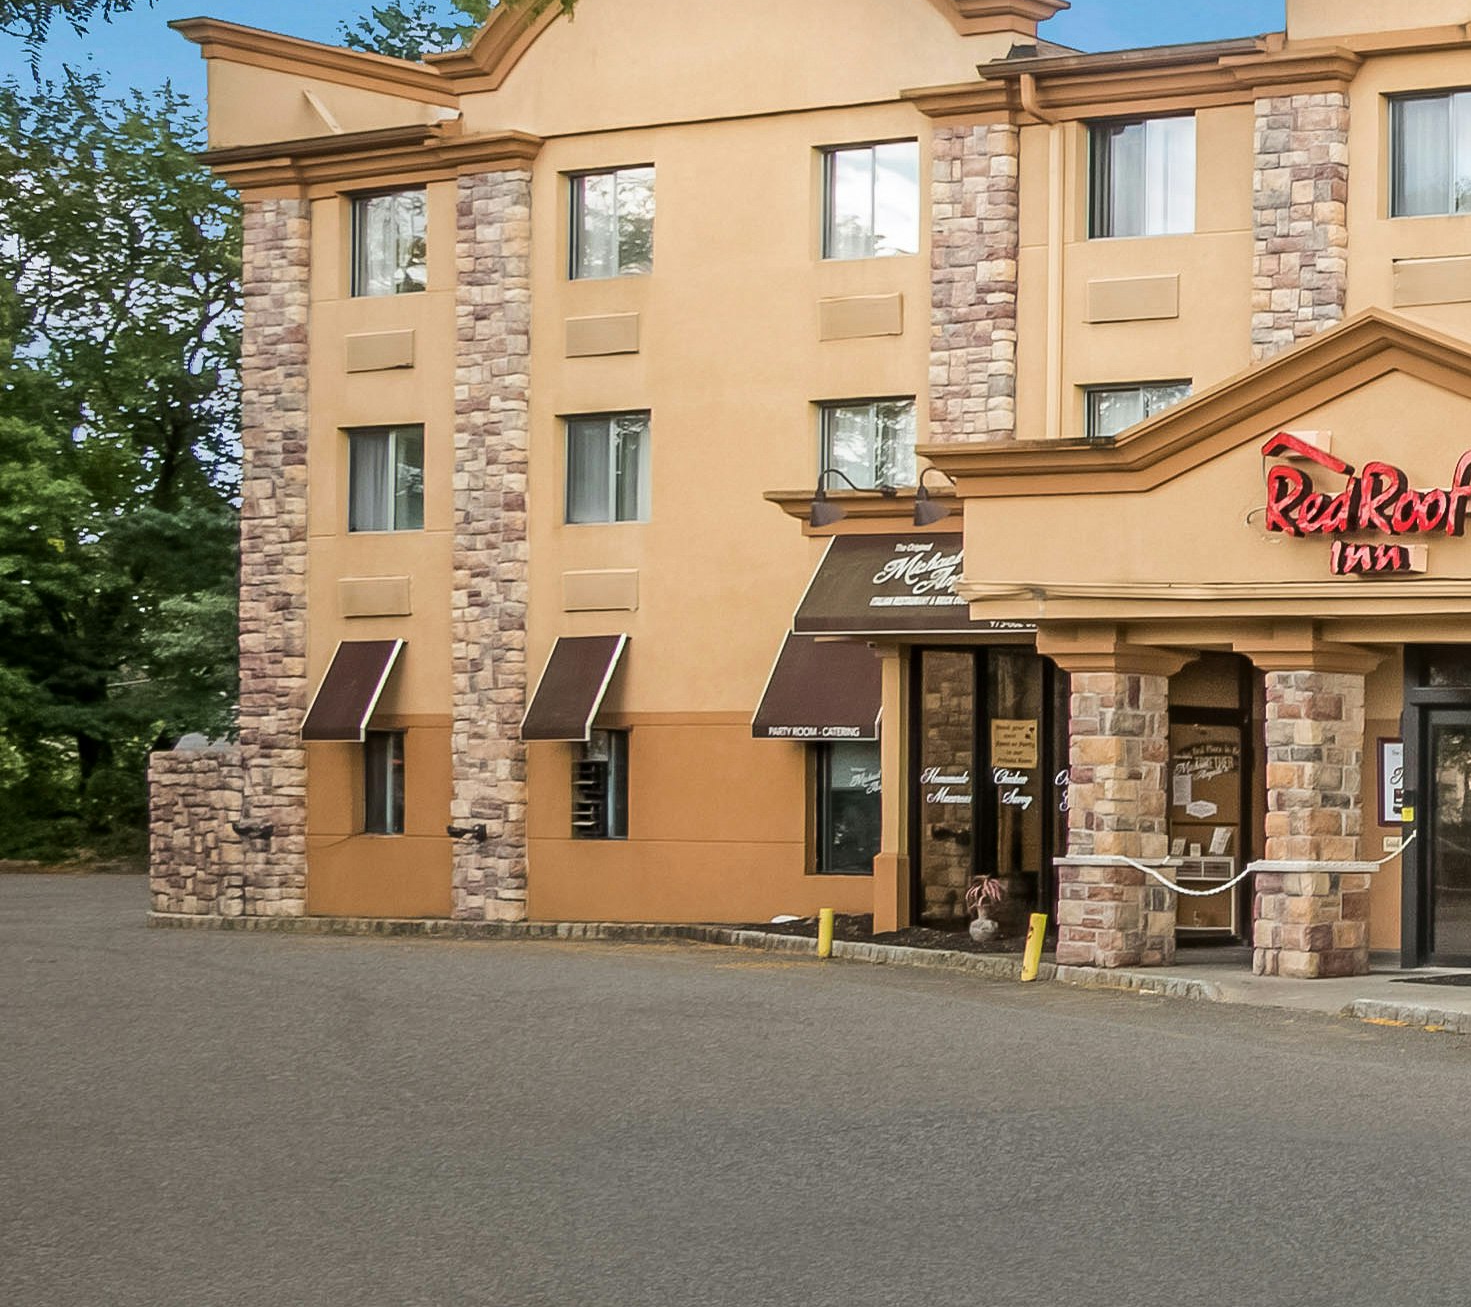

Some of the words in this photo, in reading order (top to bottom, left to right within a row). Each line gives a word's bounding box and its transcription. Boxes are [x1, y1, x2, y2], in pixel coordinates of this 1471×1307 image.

[1265, 464, 1358, 536] Red
[1330, 540, 1411, 575] Inn
[768, 726, 792, 737] PARTY
[792, 726, 818, 737] ROOM
[822, 726, 861, 737] CATERING
